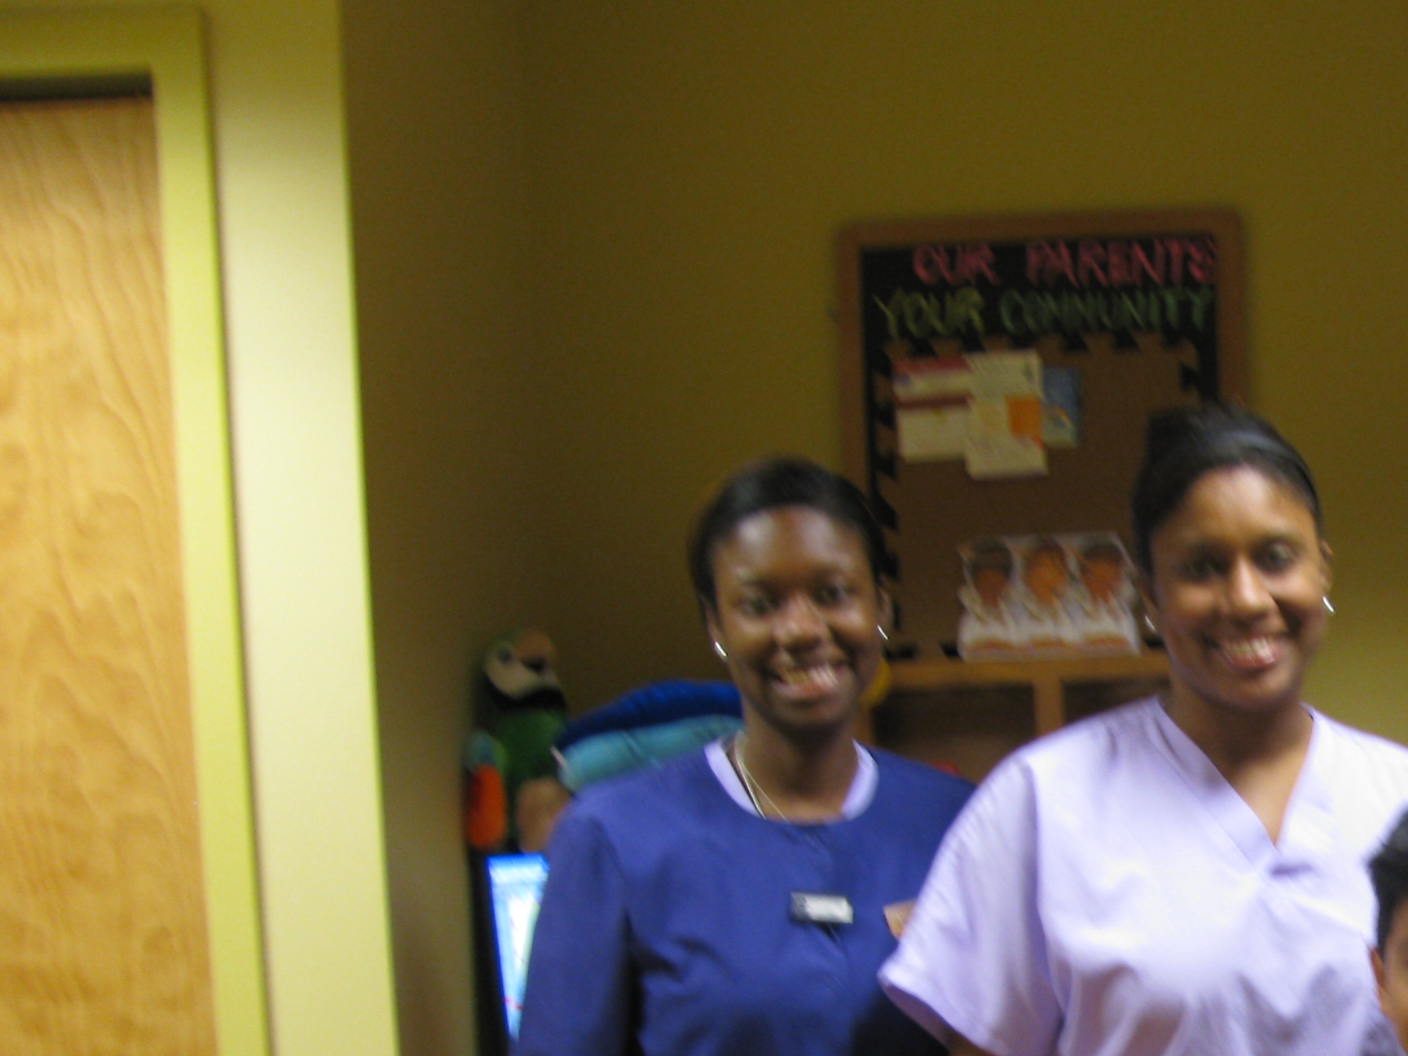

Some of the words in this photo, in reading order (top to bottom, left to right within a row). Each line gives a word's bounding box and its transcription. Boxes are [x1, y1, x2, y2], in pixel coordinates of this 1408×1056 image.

[912, 242, 999, 286] OUR
[1025, 237, 1216, 286] PARENTS
[872, 288, 986, 336] YOUR
[1000, 286, 1216, 335] COMMUNITY
